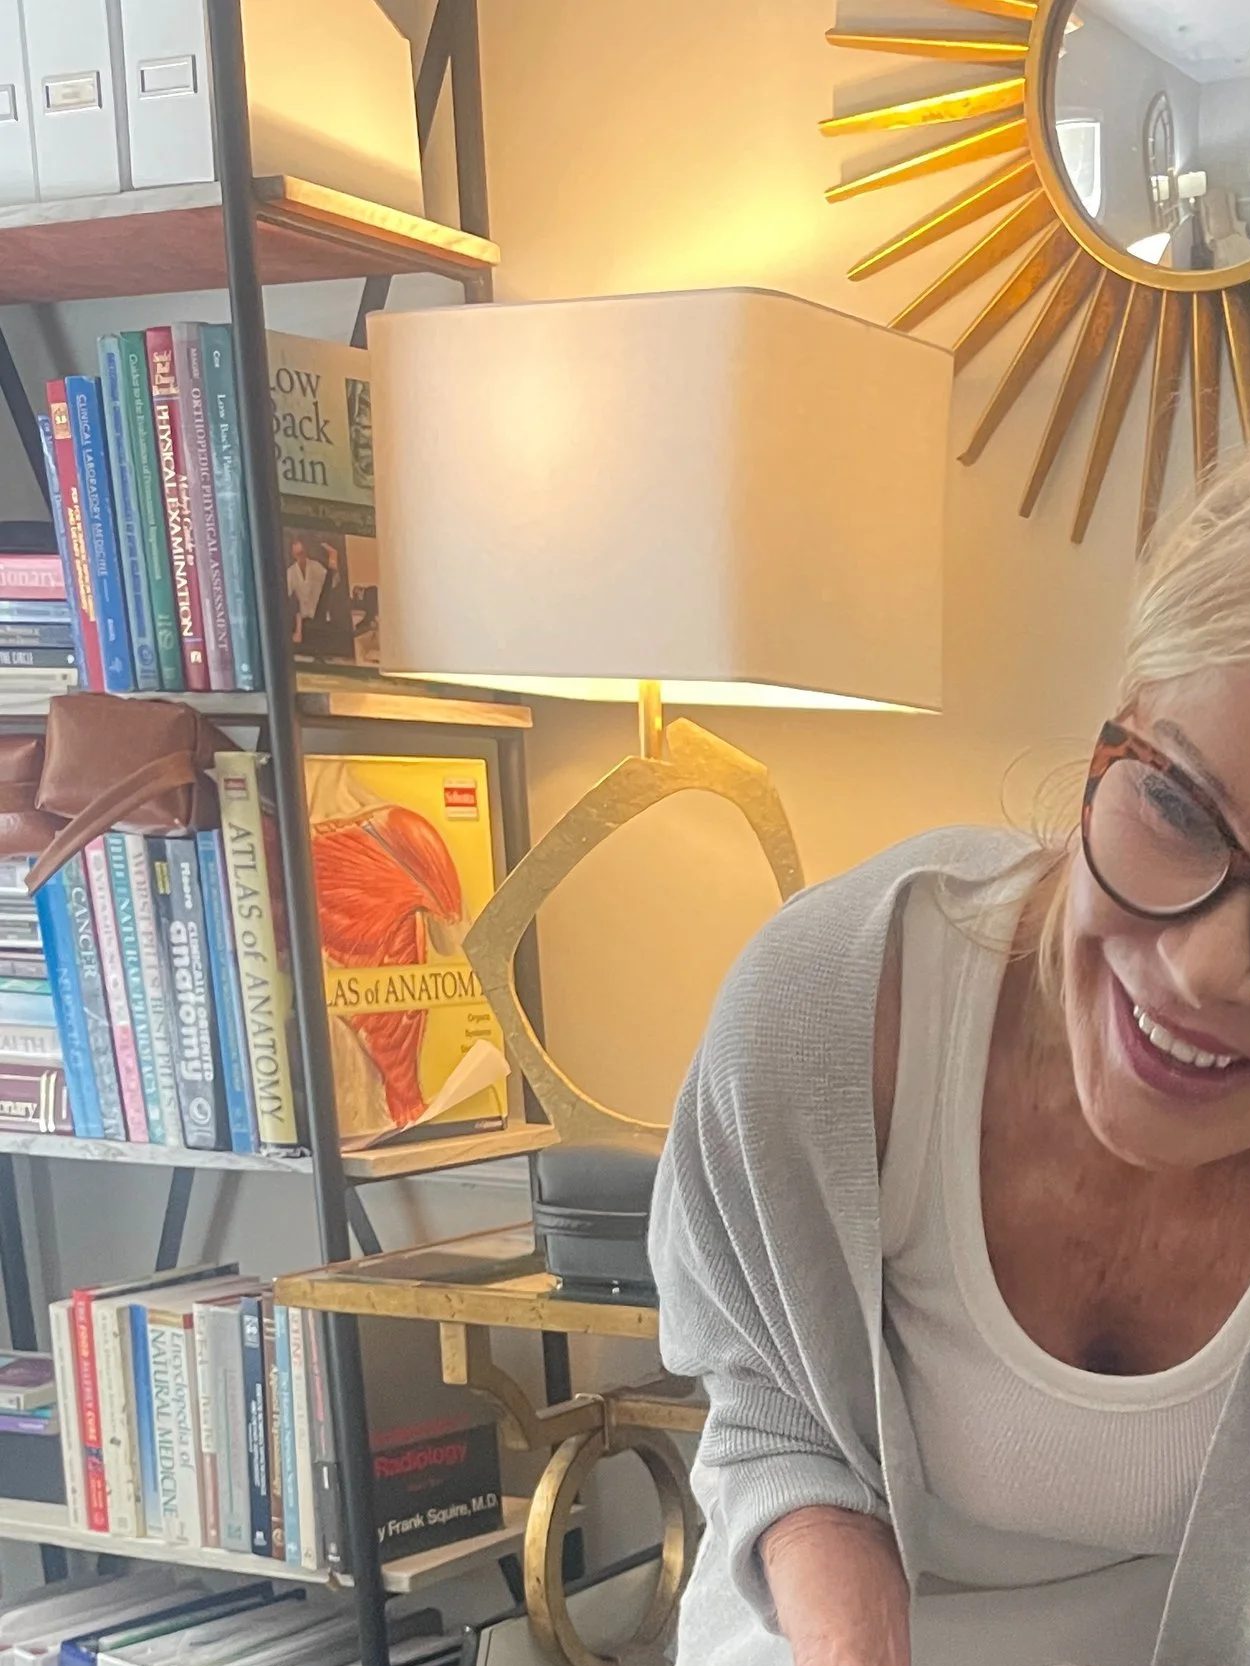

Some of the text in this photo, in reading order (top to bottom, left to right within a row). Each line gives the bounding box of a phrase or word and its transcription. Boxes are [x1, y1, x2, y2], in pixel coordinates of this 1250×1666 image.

[129, 354, 140, 386] Guides
[217, 394, 227, 420] Low
[156, 404, 177, 493] PHYSICAL
[220, 423, 232, 452] Back
[76, 394, 107, 577] CLINICAL LABORATORY MEDICINE
[191, 387, 229, 651] ORTHOPEDIC PHYSICAL ASSESSMENT
[166, 497, 194, 636] EXAMINATION
[180, 862, 193, 909] Moore
[71, 886, 98, 978] CANCER
[229, 822, 284, 1124] ATLAS of ANATOMY
[119, 895, 158, 1094] NATURAL PHARMACY
[169, 920, 203, 1081] anatomy
[187, 921, 214, 1082] CLINICALLY ORIENTED
[365, 980, 381, 1004] of
[80, 1325, 91, 1357] FOOD
[83, 1361, 95, 1408] ALLERGY
[86, 1411, 98, 1441] CURE
[150, 1329, 178, 1518] NATURAL MEDICINE
[170, 1332, 194, 1470] Encyclopedia of
[374, 1442, 467, 1477] Radiology
[388, 1513, 425, 1537] Frank
[427, 1502, 472, 1525] Squire,
[472, 1493, 499, 1512] M.D.
